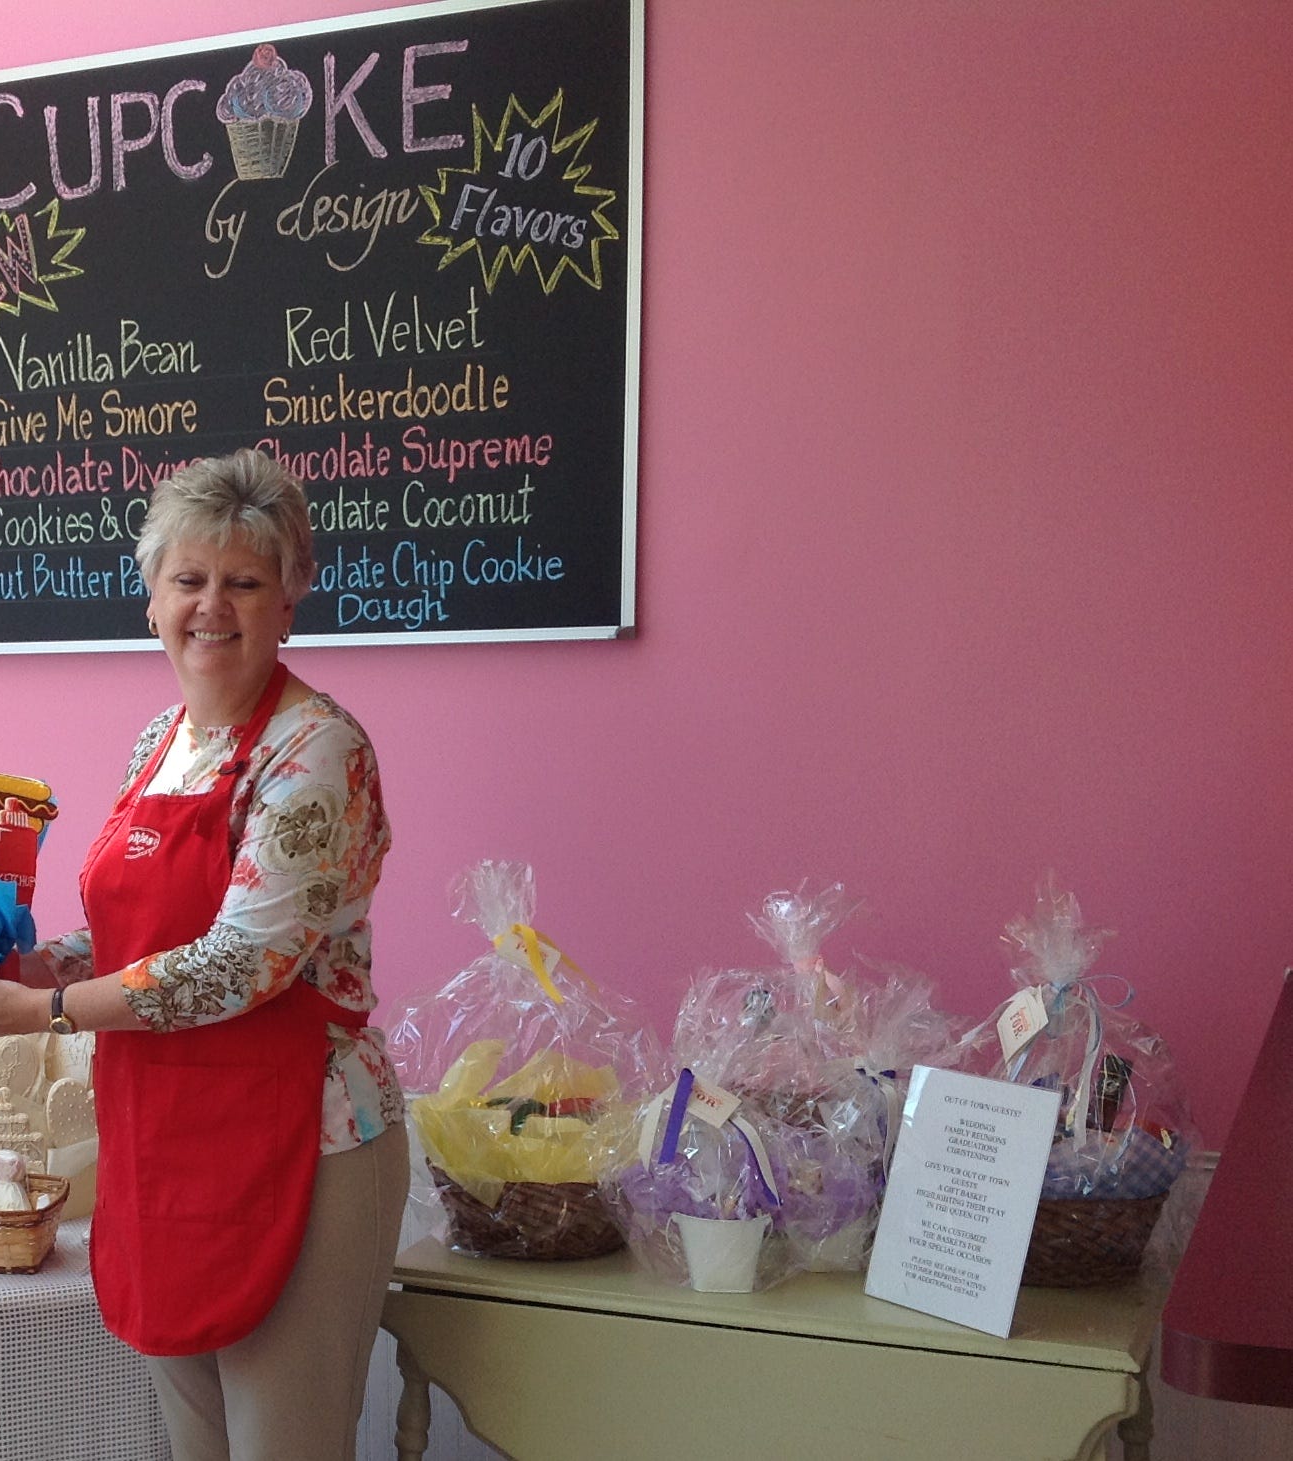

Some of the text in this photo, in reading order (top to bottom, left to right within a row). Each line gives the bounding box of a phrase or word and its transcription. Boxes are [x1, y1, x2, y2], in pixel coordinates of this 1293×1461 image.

[497, 132, 548, 181] 10
[204, 160, 421, 279] by design
[450, 183, 588, 249] Flavors
[286, 286, 485, 368] Red Velvet
[120, 318, 203, 379] Bean
[57, 392, 93, 442] Me
[101, 388, 198, 437] Smore
[263, 363, 510, 427] Snickerdoodle
[402, 424, 554, 484] Supreme
[99, 496, 124, 541] &
[307, 473, 536, 533] colate Coconut
[32, 553, 114, 599] Butter
[309, 535, 566, 600] olate Chip Cookie
[337, 590, 449, 631] Dough
[944, 1095, 959, 1105] OUT
[970, 1100, 991, 1111] TOWN
[991, 1104, 1022, 1118] GUESTS?
[960, 1118, 996, 1133] WEDDINGS
[944, 1125, 1007, 1146] FAMILY REUNIONS
[948, 1136, 998, 1154] GRADUATIONS
[924, 1161, 941, 1171] GIVE
[942, 1164, 962, 1175] YOUR
[962, 1170, 977, 1179] OUT
[989, 1176, 1011, 1187] TOWN
[943, 1185, 960, 1196] GIFT
[960, 1189, 988, 1202] BASKET
[951, 1177, 978, 1189] GUESTS
[916, 1188, 1006, 1218] HIGHLIGHTING THEIR STAY
[935, 1203, 948, 1213] THE
[949, 1207, 972, 1219] QUEEN
[973, 1214, 990, 1224] CITY
[922, 1230, 981, 1253] THE BASKETS FOR
[932, 1222, 947, 1233] CAN
[909, 1236, 991, 1265] YOUR SPECIAL OCCASION
